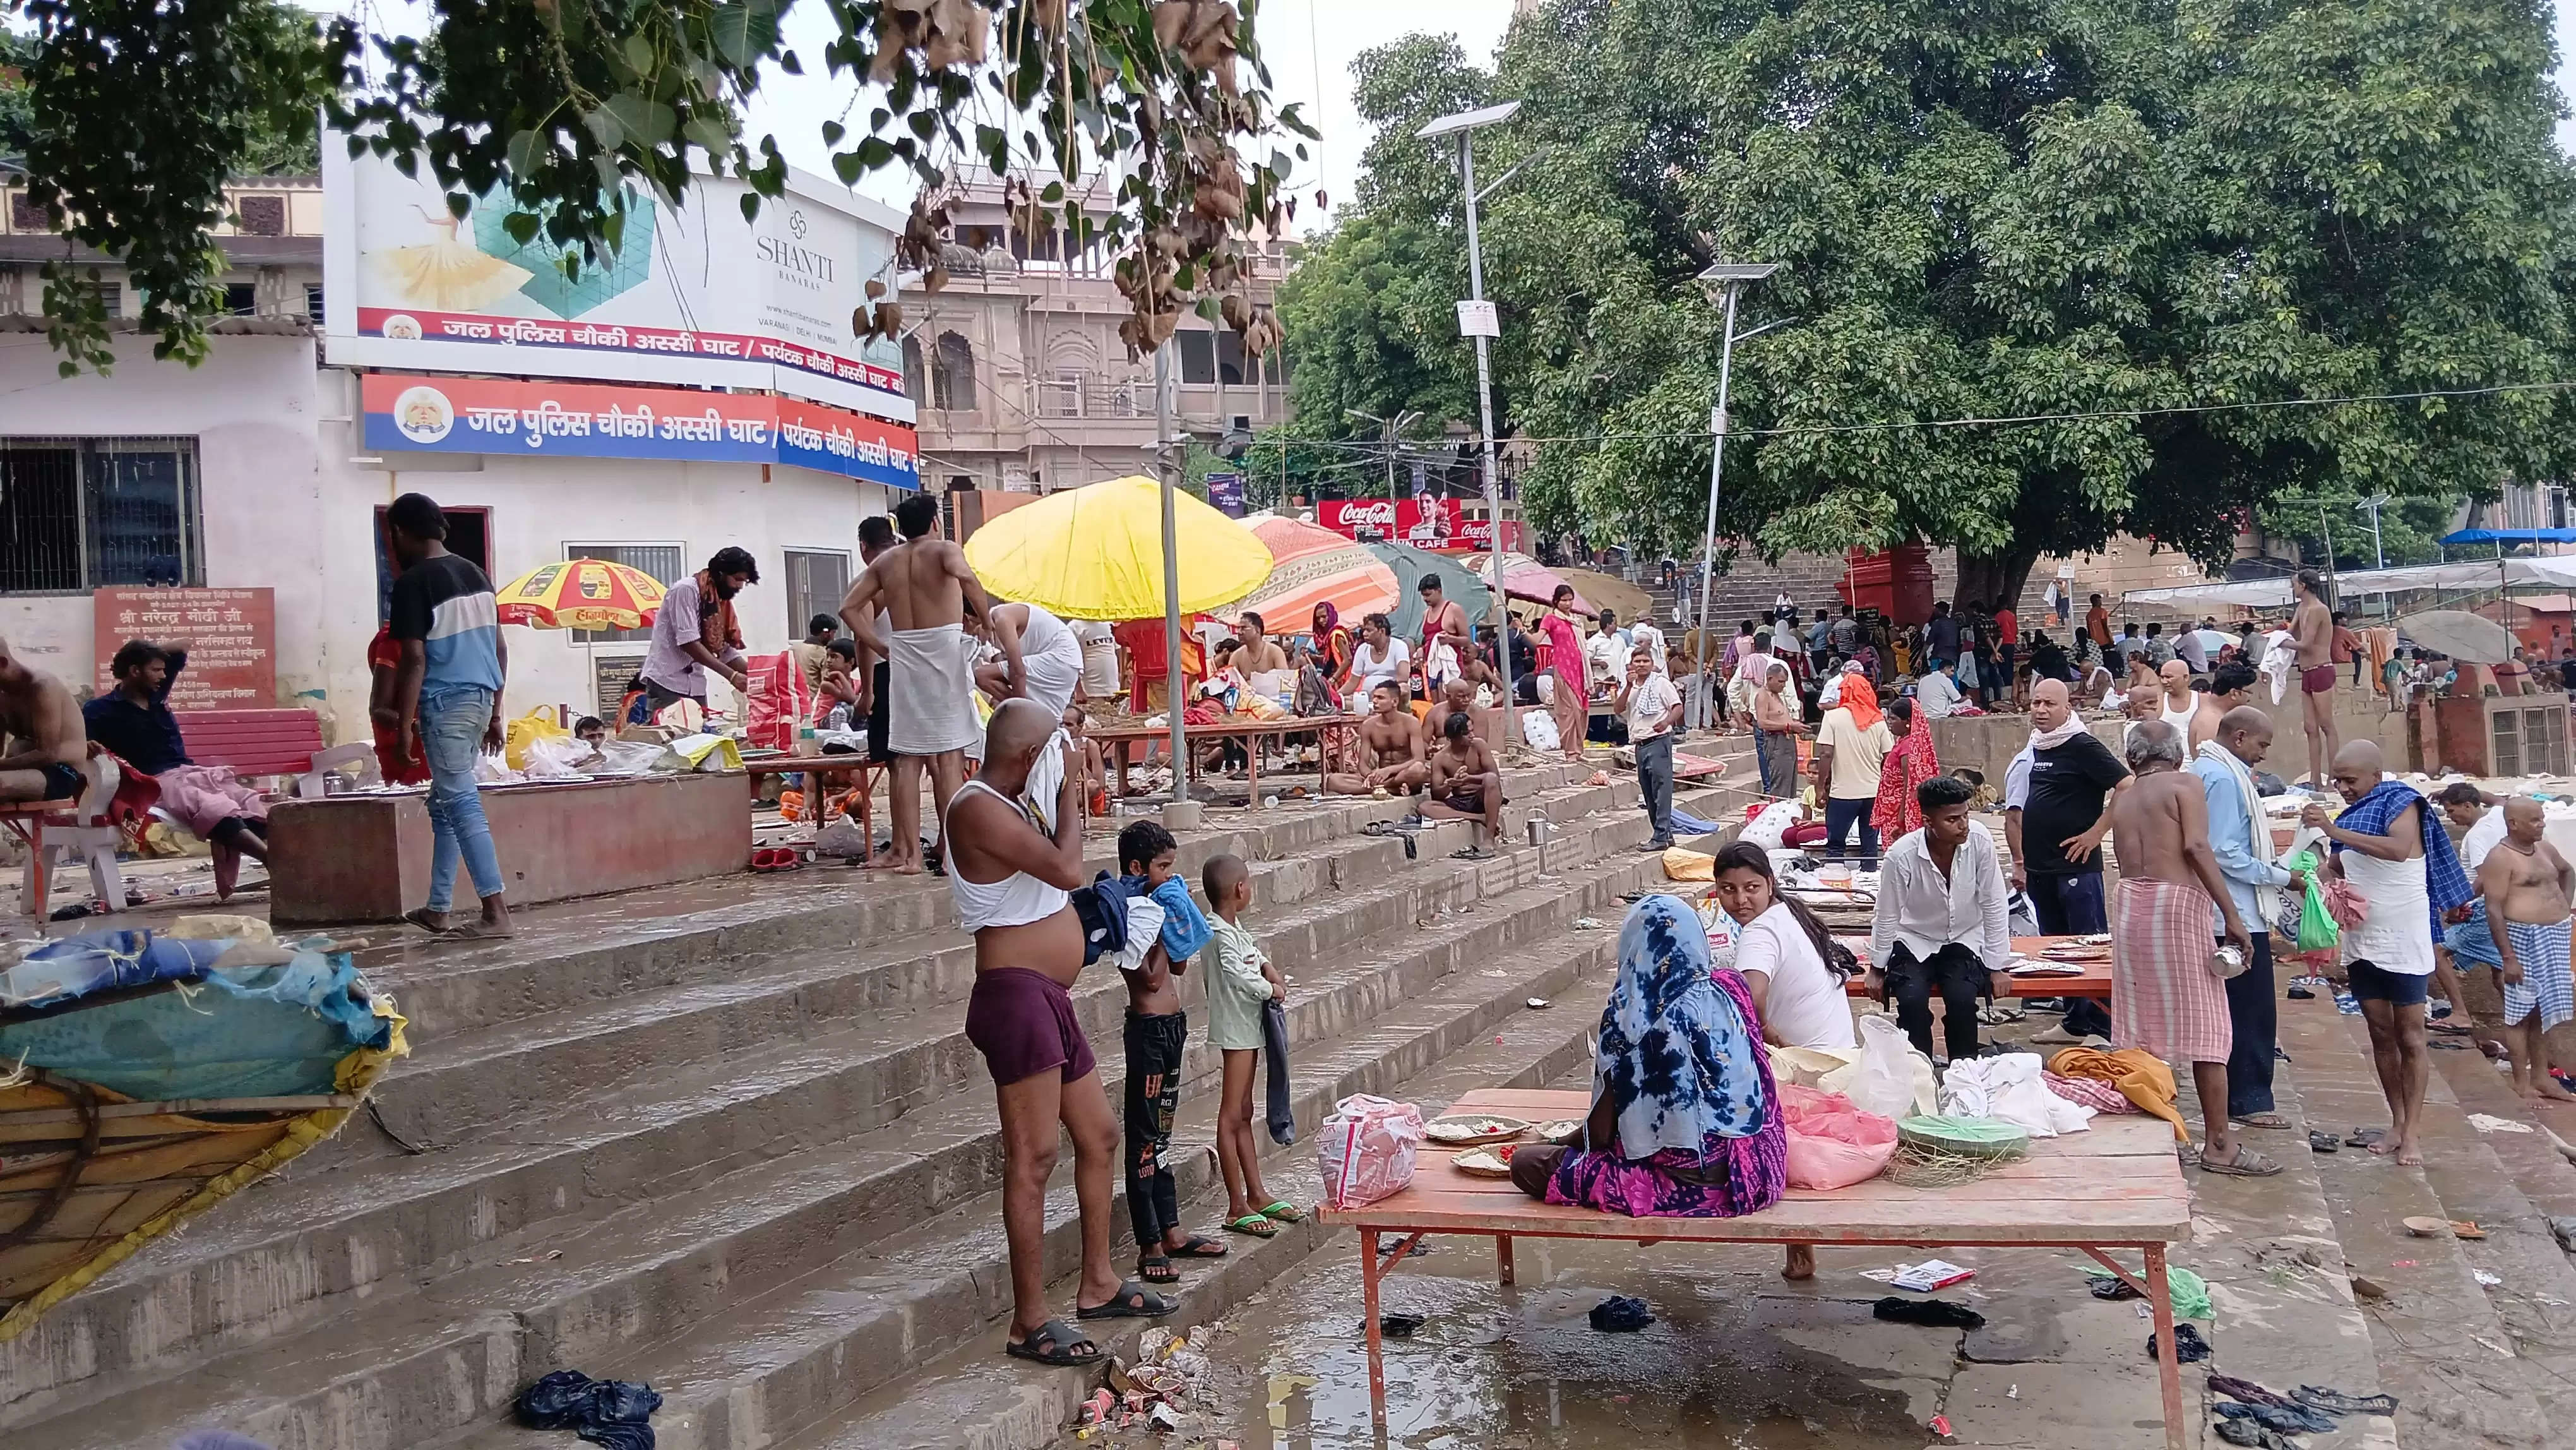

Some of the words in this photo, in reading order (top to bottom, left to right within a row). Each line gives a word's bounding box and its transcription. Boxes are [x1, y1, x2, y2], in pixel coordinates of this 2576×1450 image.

[757, 236, 834, 283] SHANTI
[779, 270, 820, 291] BANARAS
[442, 320, 493, 339] जल
[498, 320, 567, 346] पुलिस
[571, 325, 629, 348] चौकी
[634, 332, 696, 353] अस्सी
[701, 339, 741, 356] घाट
[760, 342, 804, 366] पर्यटक
[806, 352, 835, 374] चौकी
[837, 362, 868, 383] अस्सी
[869, 373, 888, 389] घाट
[465, 407, 518, 434] जल
[522, 400, 592, 448] पुलिस
[597, 403, 655, 438] चौकी
[660, 408, 723, 441] अस्सी
[727, 419, 767, 444] घाट
[782, 417, 823, 452] पर्यटक
[825, 424, 856, 459] चौकी
[857, 436, 888, 467] अस्सी
[889, 447, 909, 472] घाट
[120, 608, 137, 624] श्री
[141, 609, 181, 625] नरेन्द्र
[187, 608, 218, 623] मोदी
[224, 608, 242, 623] जी
[237, 635, 254, 646] राव
[1086, 637, 1113, 646] LEVI'S
